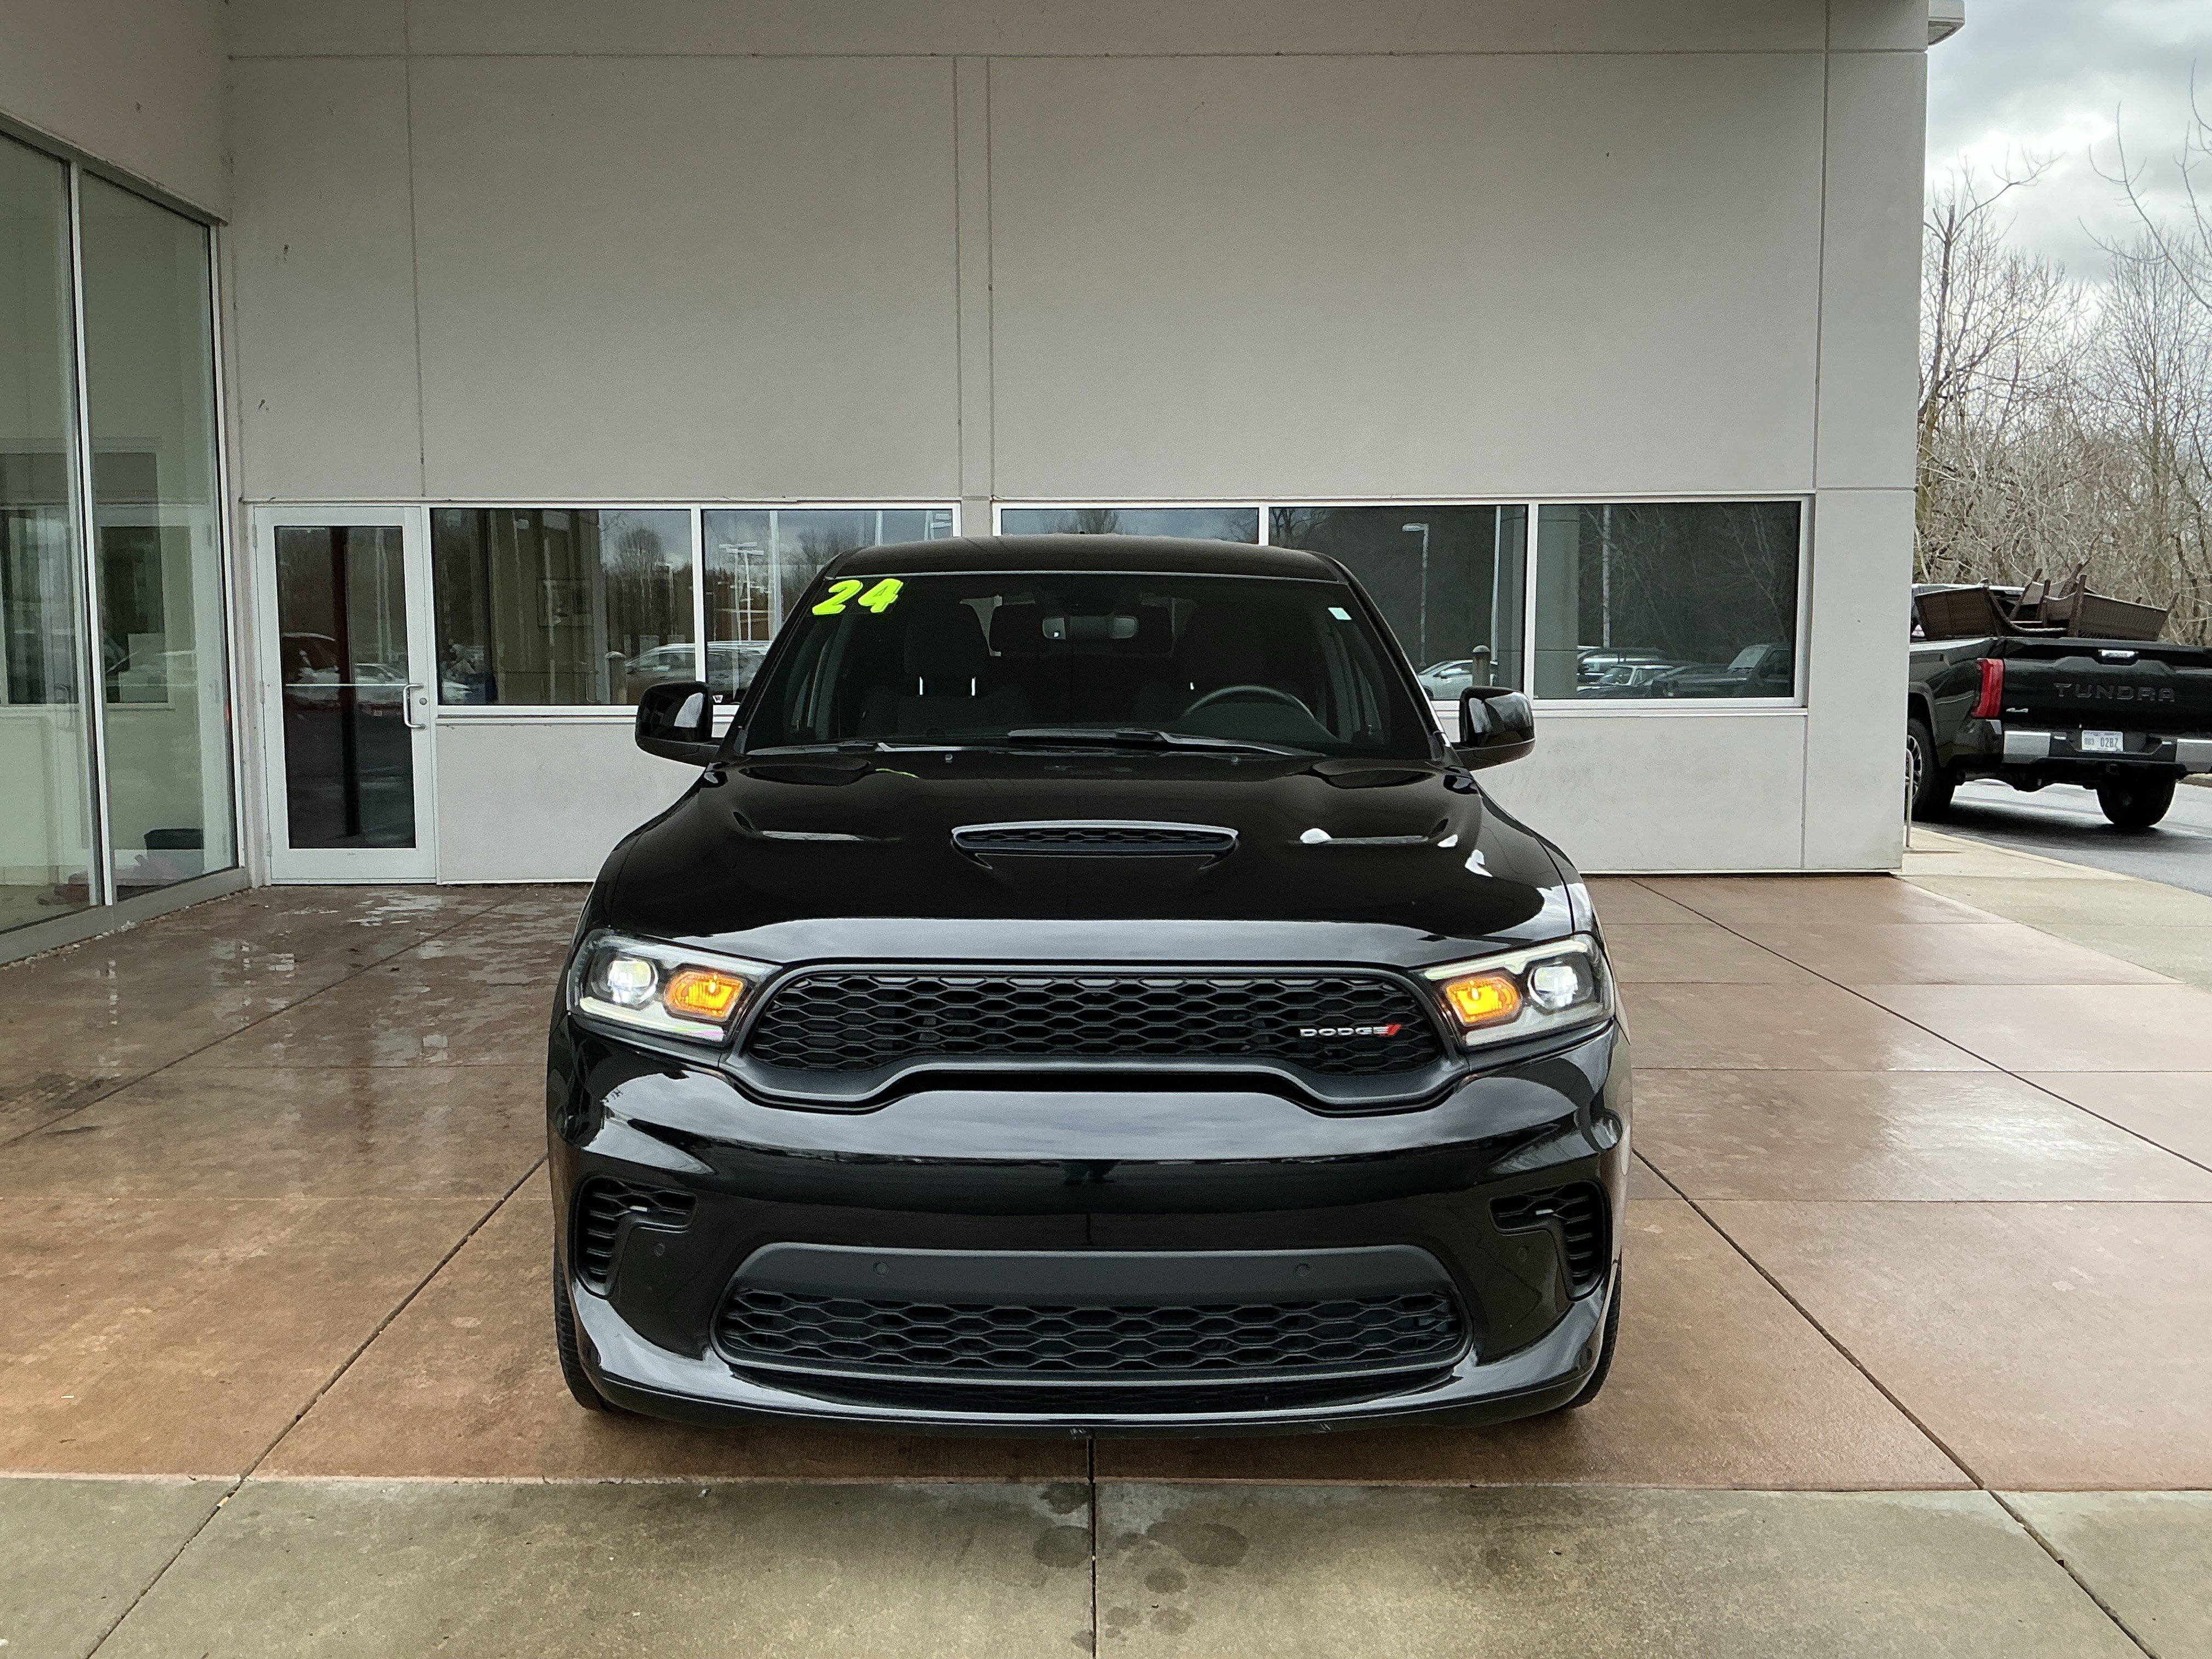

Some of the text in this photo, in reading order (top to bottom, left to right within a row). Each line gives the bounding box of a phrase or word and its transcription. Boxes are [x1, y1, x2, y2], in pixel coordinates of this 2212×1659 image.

[812, 578, 904, 615] 24
[2053, 682, 2175, 702] TUNDRA
[1300, 1026, 1390, 1037] DODGE
